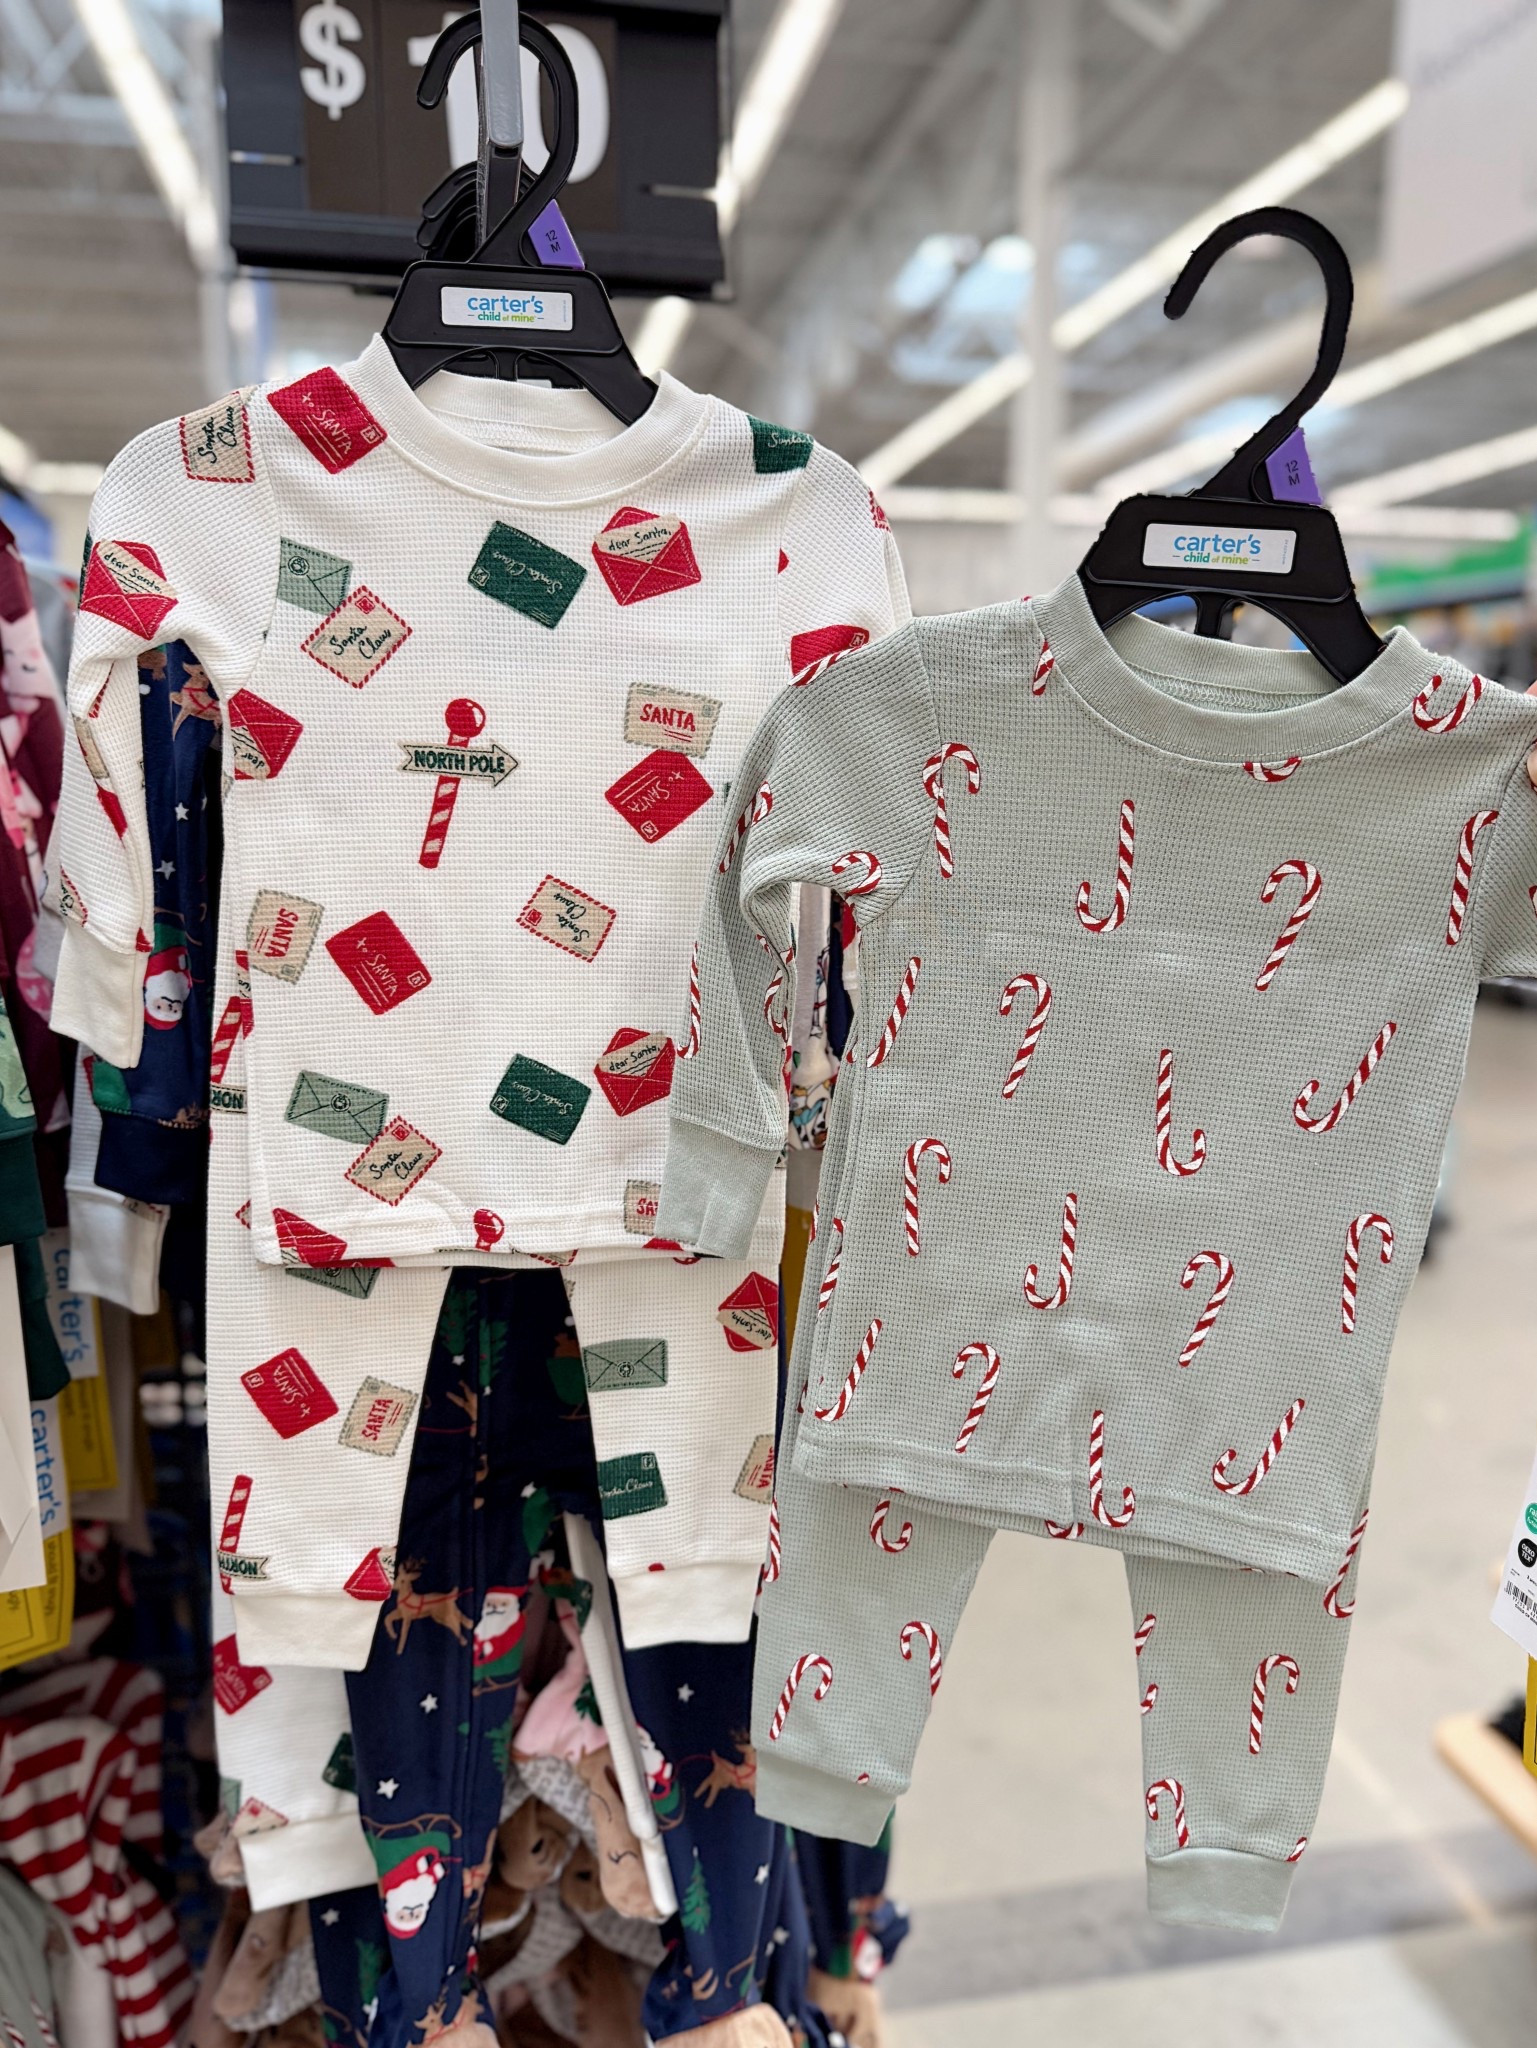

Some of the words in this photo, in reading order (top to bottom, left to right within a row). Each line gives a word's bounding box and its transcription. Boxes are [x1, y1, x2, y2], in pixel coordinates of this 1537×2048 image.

[300, 0, 366, 120] $
[407, 11, 611, 184] 10
[545, 230, 558, 242] 12
[550, 242, 561, 253] M
[467, 295, 544, 313] carter's
[477, 311, 500, 321] child
[511, 313, 535, 322] mine
[217, 405, 237, 447] Claus
[312, 409, 353, 454] SANTA
[198, 416, 218, 464] Santa
[1284, 460, 1299, 473] 12
[1288, 473, 1300, 486] M
[608, 537, 631, 551] dear
[1173, 534, 1262, 555] carter's
[103, 552, 129, 570] dear
[492, 551, 526, 576] Claus
[1183, 552, 1210, 563] child
[1211, 555, 1220, 563] of
[1221, 553, 1249, 565] mine
[527, 567, 563, 595] Santa
[329, 625, 368, 656] Santa
[359, 629, 392, 660] Claus
[640, 703, 696, 732] SANTA
[240, 752, 266, 769] dear
[413, 749, 466, 772] NORTH
[469, 754, 505, 774] POLE
[627, 780, 671, 812] SANTA
[553, 893, 587, 920] Claus
[264, 908, 299, 958] SANTA
[555, 913, 590, 943] Santa
[366, 953, 399, 997] SANTA
[609, 1056, 629, 1072] dear
[512, 1081, 541, 1102] Claus
[541, 1093, 573, 1115] Santa
[369, 1151, 403, 1180] Santa
[394, 1152, 423, 1180] Claus
[755, 1328, 772, 1341] dear
[273, 1364, 304, 1404] SANTA
[360, 1398, 394, 1441] SANTA
[31, 1408, 62, 1527] carter's
[625, 1477, 653, 1493] Claus
[1521, 1543, 1535, 1557] OEKO
